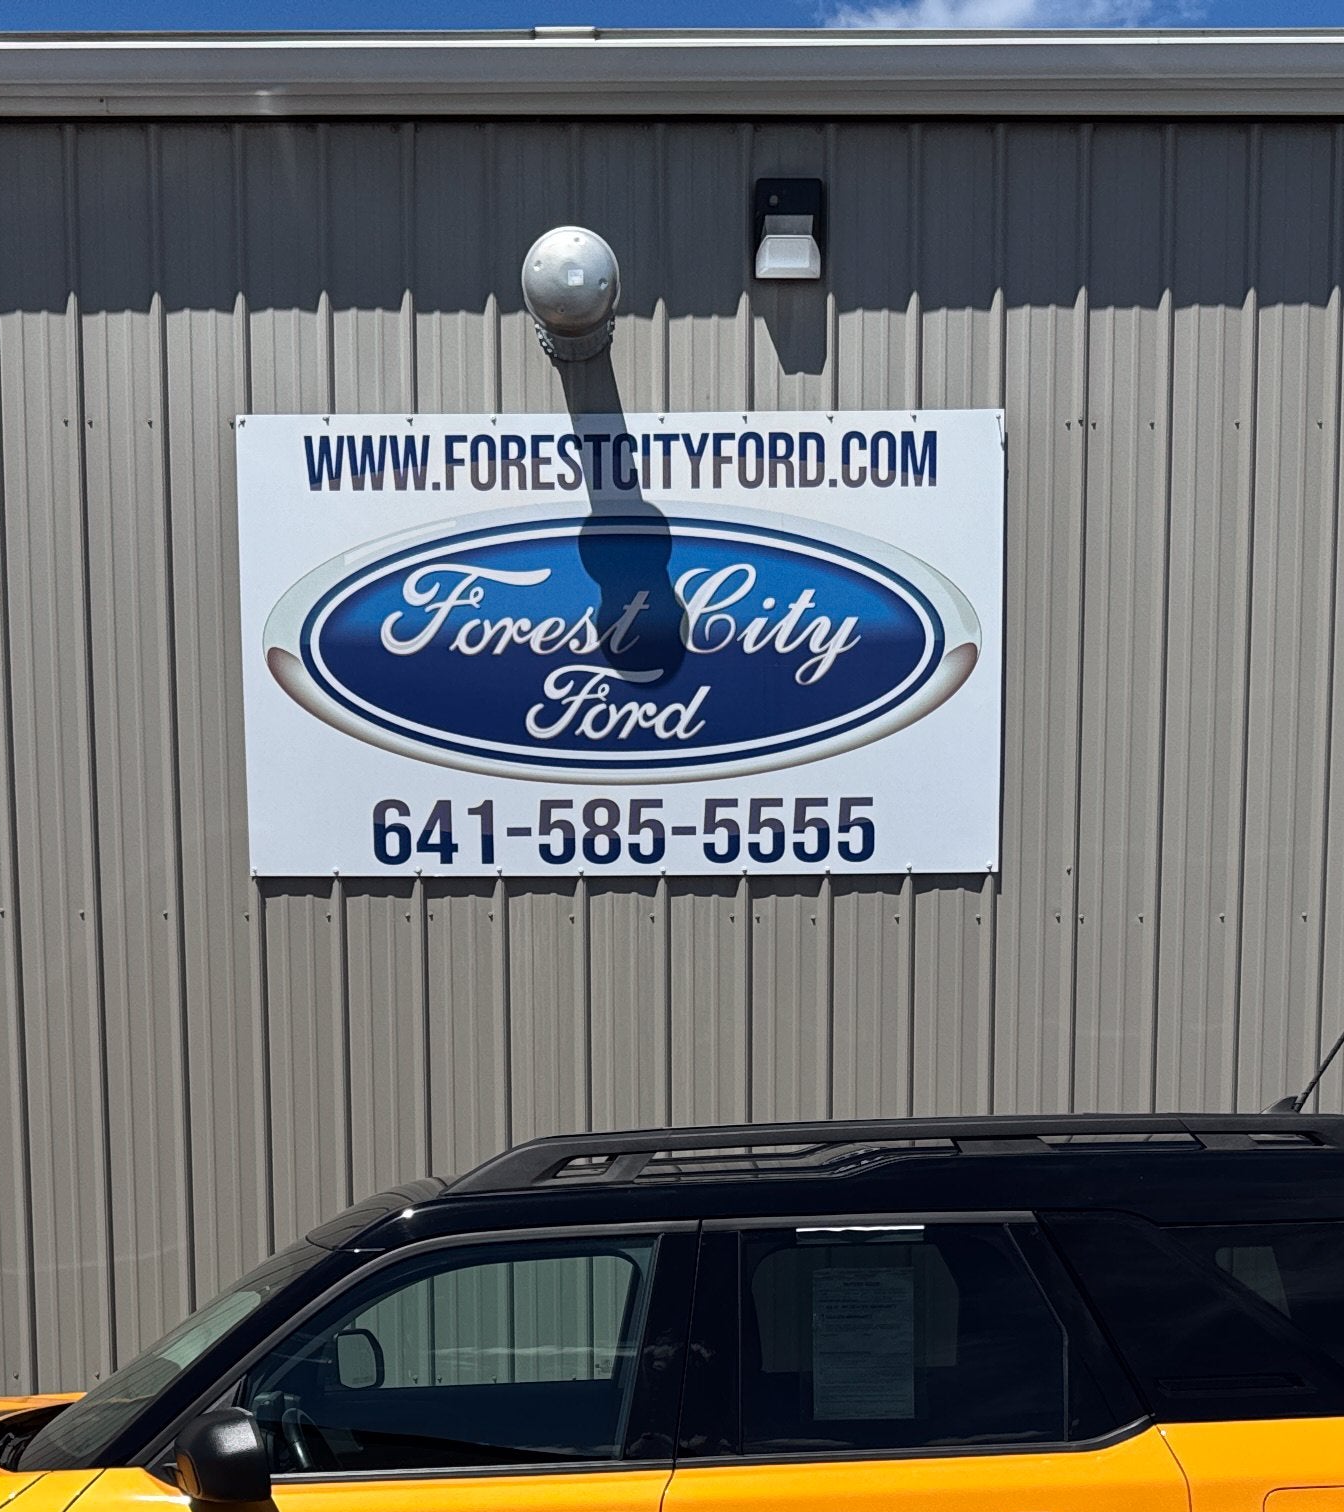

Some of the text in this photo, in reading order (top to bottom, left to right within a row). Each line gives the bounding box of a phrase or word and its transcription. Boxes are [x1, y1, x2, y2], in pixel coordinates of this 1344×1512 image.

[303, 430, 938, 492] WWW.FORESTCITYFORD.COM
[379, 562, 863, 686] Forest City
[525, 664, 712, 741] Ford
[372, 796, 876, 866] 641-585-5555
